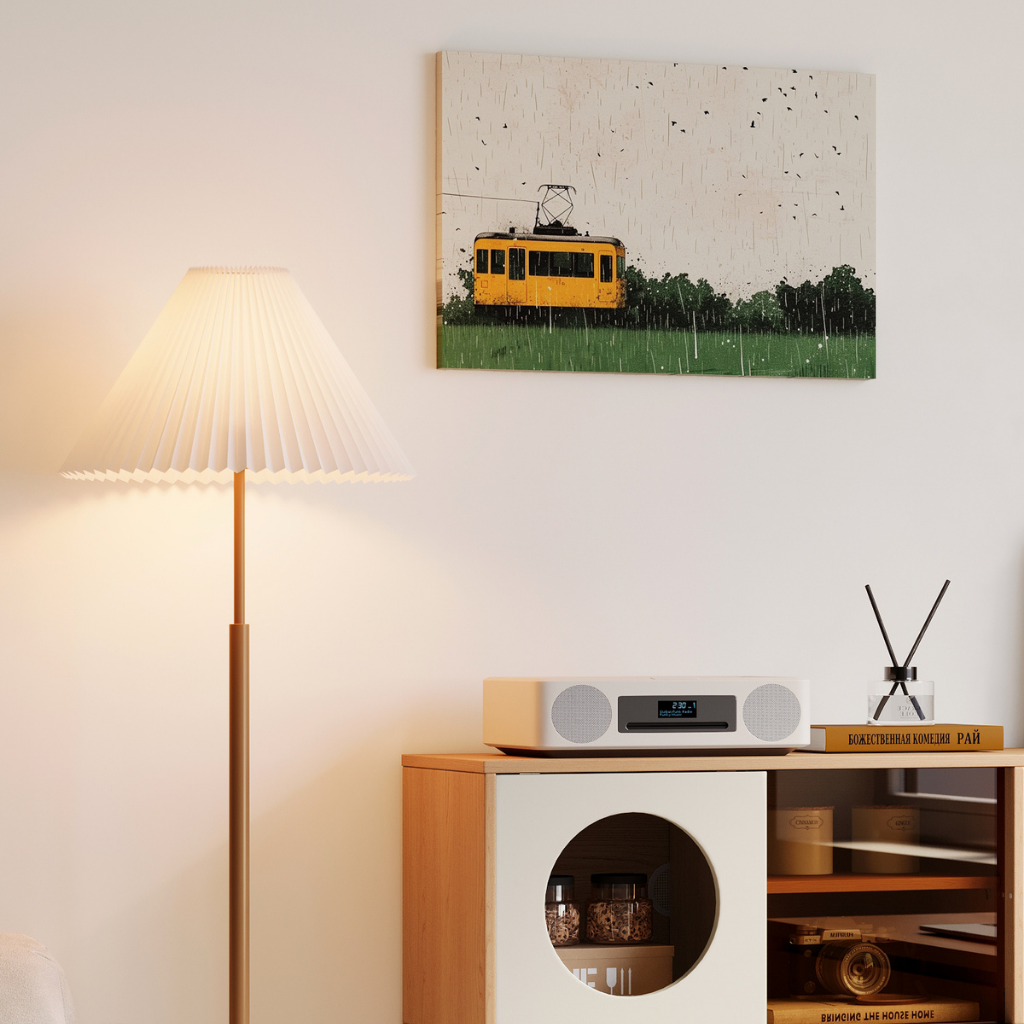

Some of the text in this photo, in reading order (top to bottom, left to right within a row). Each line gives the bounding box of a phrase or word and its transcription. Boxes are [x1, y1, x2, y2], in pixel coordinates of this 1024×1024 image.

[848, 729, 980, 746] БОЖЕСТВЕННАЯ КОМЕДИЯ РАЙ
